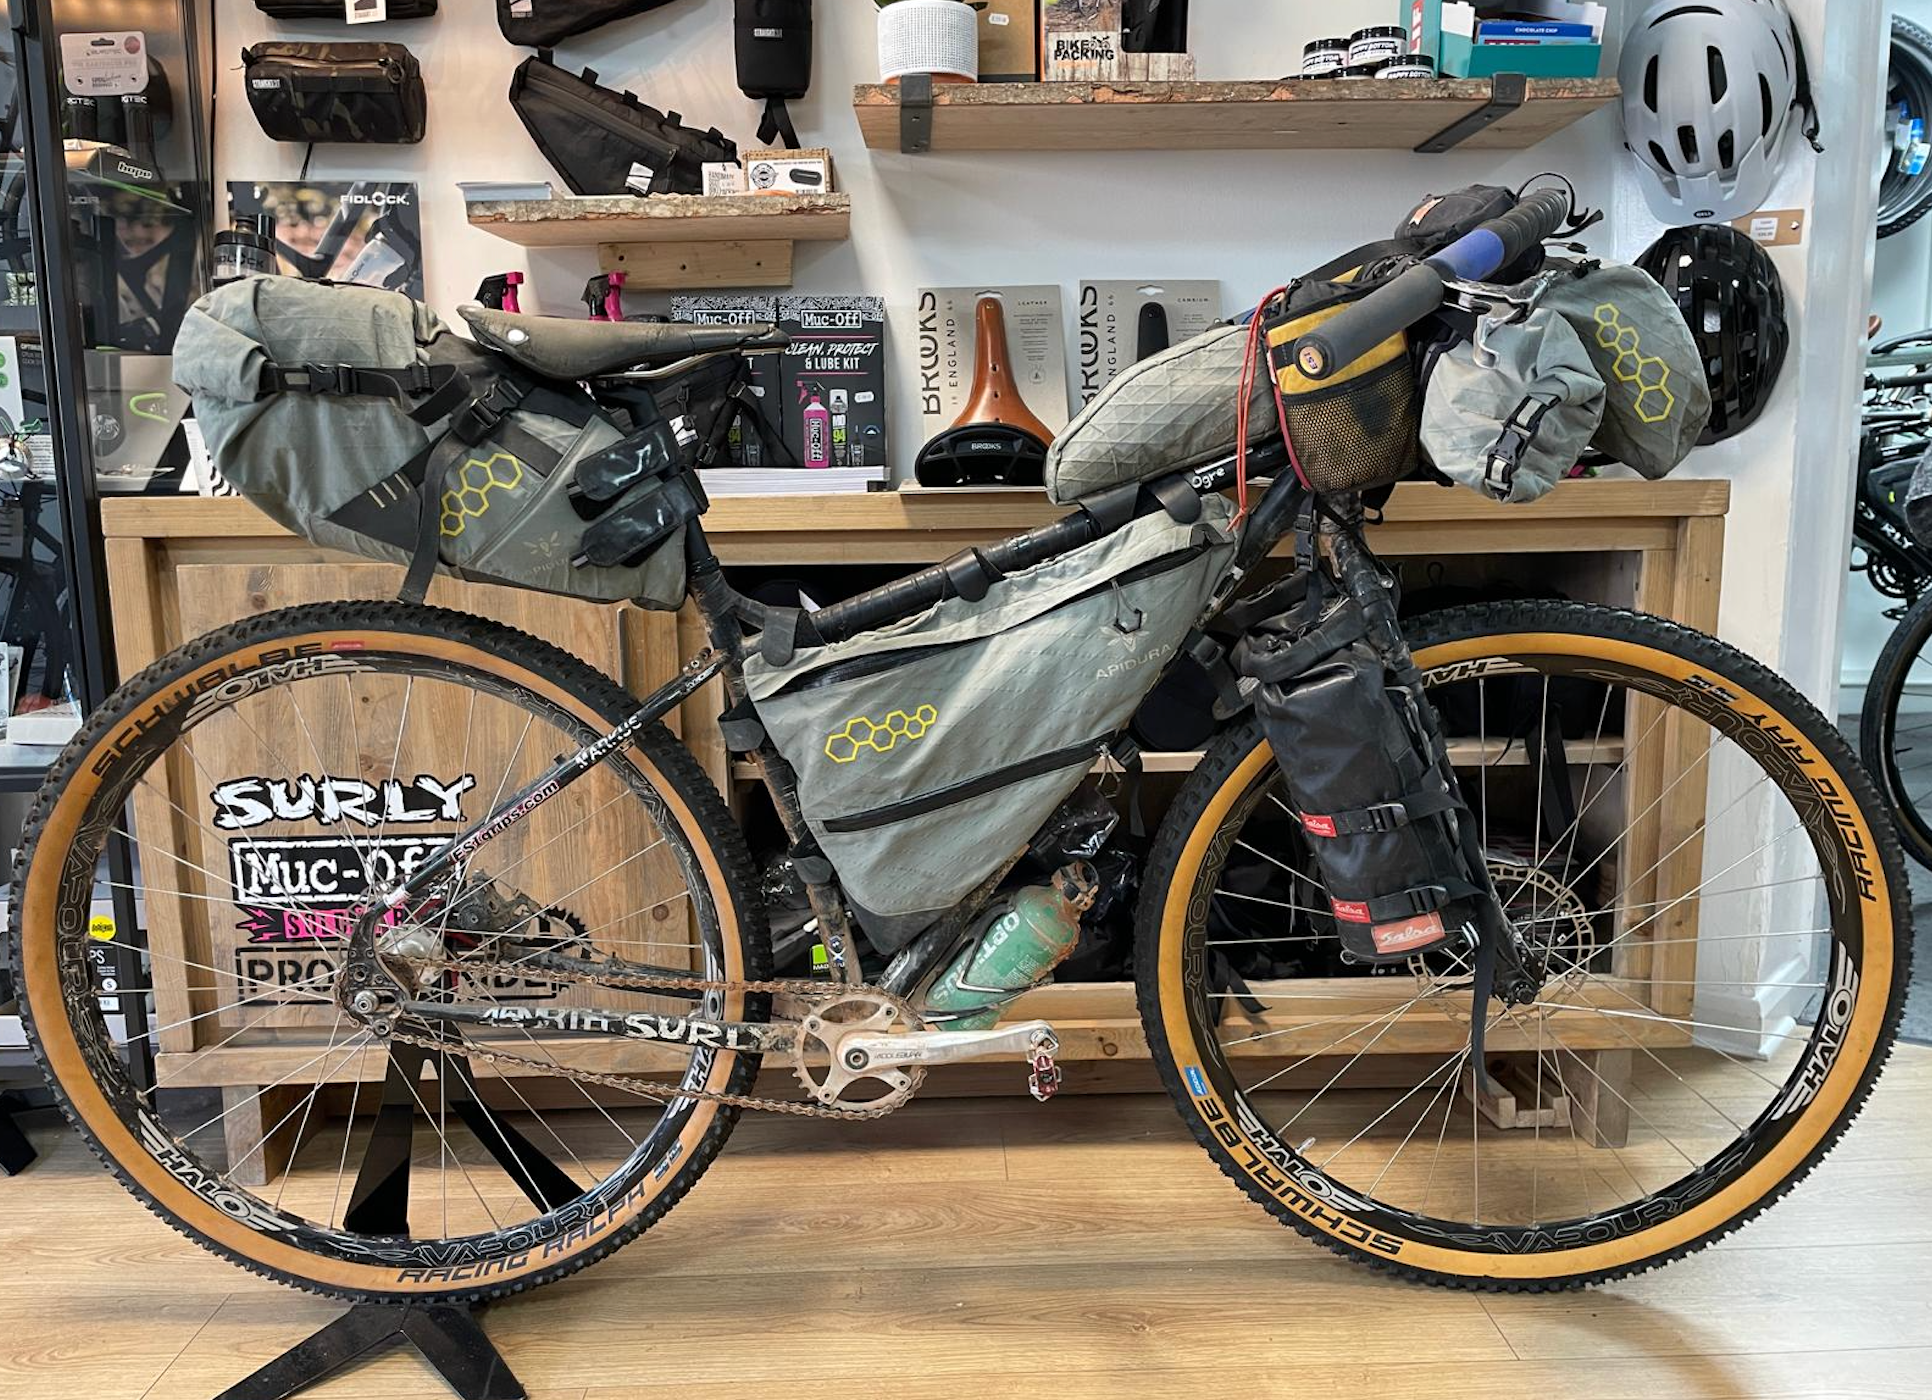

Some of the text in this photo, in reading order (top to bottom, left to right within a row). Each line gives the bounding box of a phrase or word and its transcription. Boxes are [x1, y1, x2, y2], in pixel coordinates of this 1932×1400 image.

[1054, 50, 1114, 61] PACKING
[1057, 40, 1089, 50] BIKE
[118, 161, 152, 179] hope
[340, 191, 409, 205] FIDLOCK
[696, 313, 753, 325] Muc-Off
[804, 313, 860, 326] Muc-Off
[805, 357, 860, 370] & LUBE KIT
[827, 342, 879, 356] PROTECT
[918, 291, 941, 415] BROOKS
[946, 318, 958, 387] ENGLAND
[1107, 314, 1117, 383] NGLAND
[1192, 467, 1225, 489] Ogre
[1095, 643, 1172, 680] APIDURA
[91, 642, 323, 776] SCHWALBE
[214, 776, 476, 828] SURLY
[1741, 710, 1877, 903] RACING RAY
[1380, 923, 1438, 945] Salsa
[1803, 988, 1853, 1090] HALO
[156, 1148, 251, 1218] HALO
[1199, 1097, 1404, 1255] SCHWALBE
[1249, 1127, 1332, 1198] HALO
[396, 1182, 646, 1284] RACING RALPH
